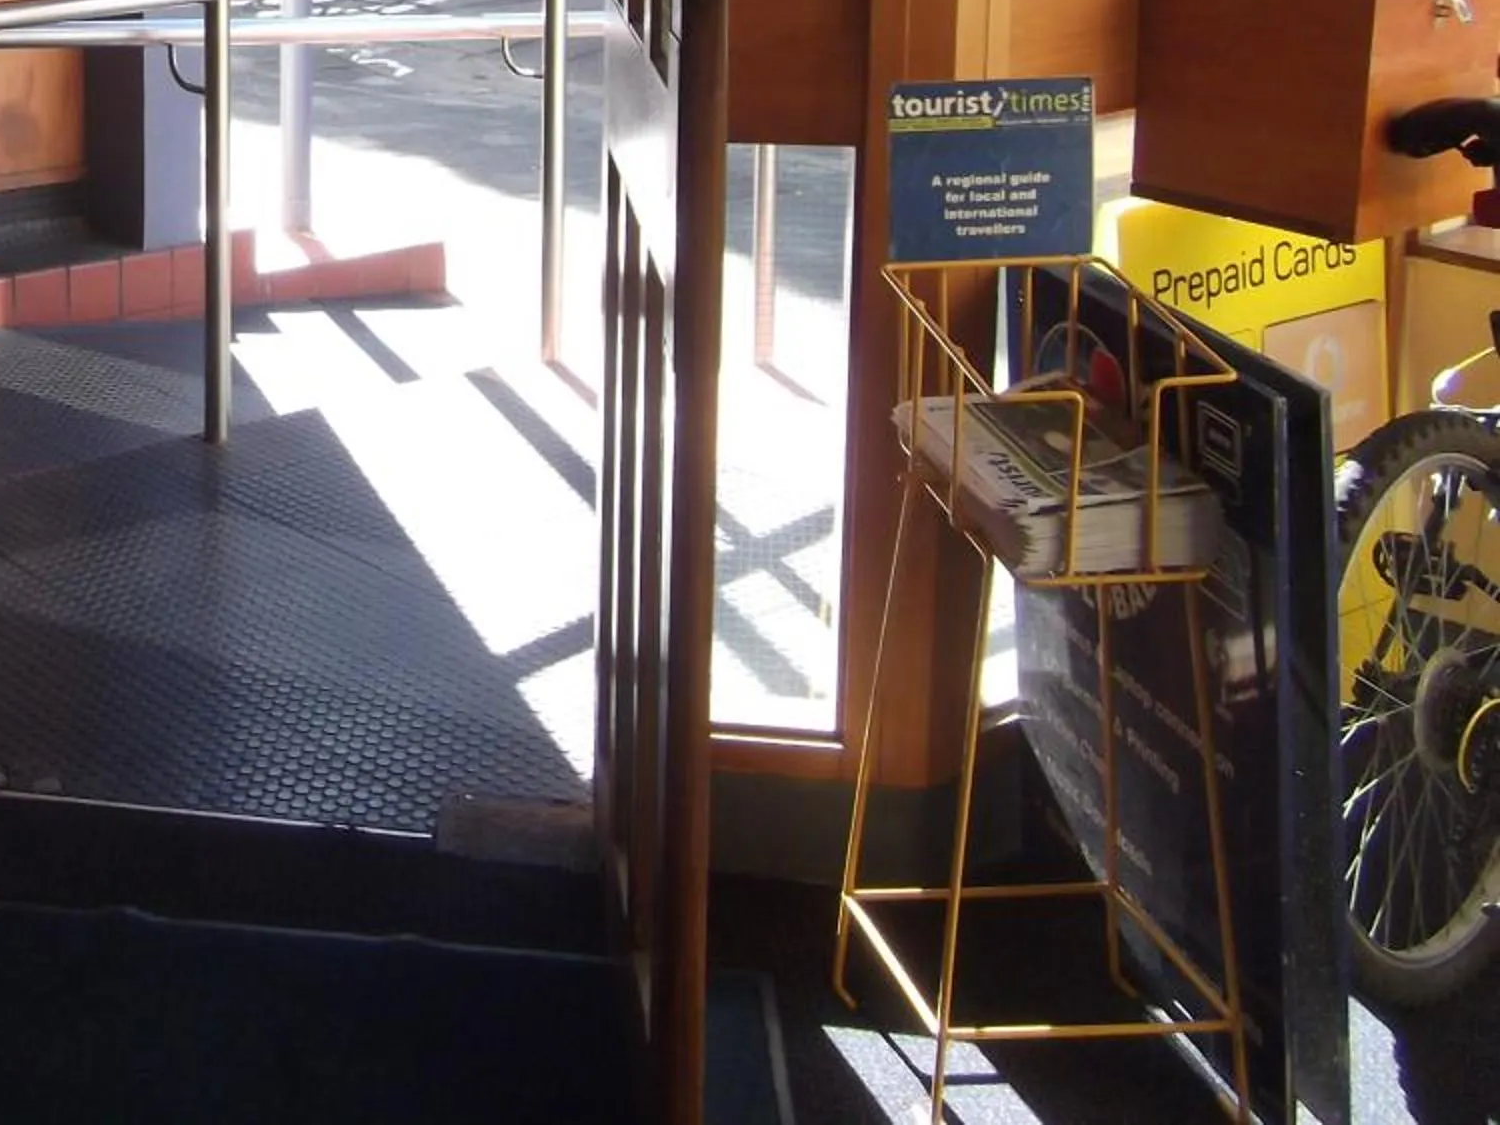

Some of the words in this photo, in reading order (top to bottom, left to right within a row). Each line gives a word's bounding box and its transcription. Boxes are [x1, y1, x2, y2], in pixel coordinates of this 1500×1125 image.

[892, 90, 993, 117] tourist
[1009, 89, 1080, 113] times
[932, 174, 943, 187] A
[946, 172, 1007, 188] regional
[1009, 171, 1052, 187] guide
[945, 191, 965, 203] for
[969, 189, 1005, 202] local
[1009, 188, 1037, 201] and
[955, 222, 1027, 236] travellers
[1152, 244, 1265, 309] Prepaid
[1273, 240, 1357, 282] Cards
